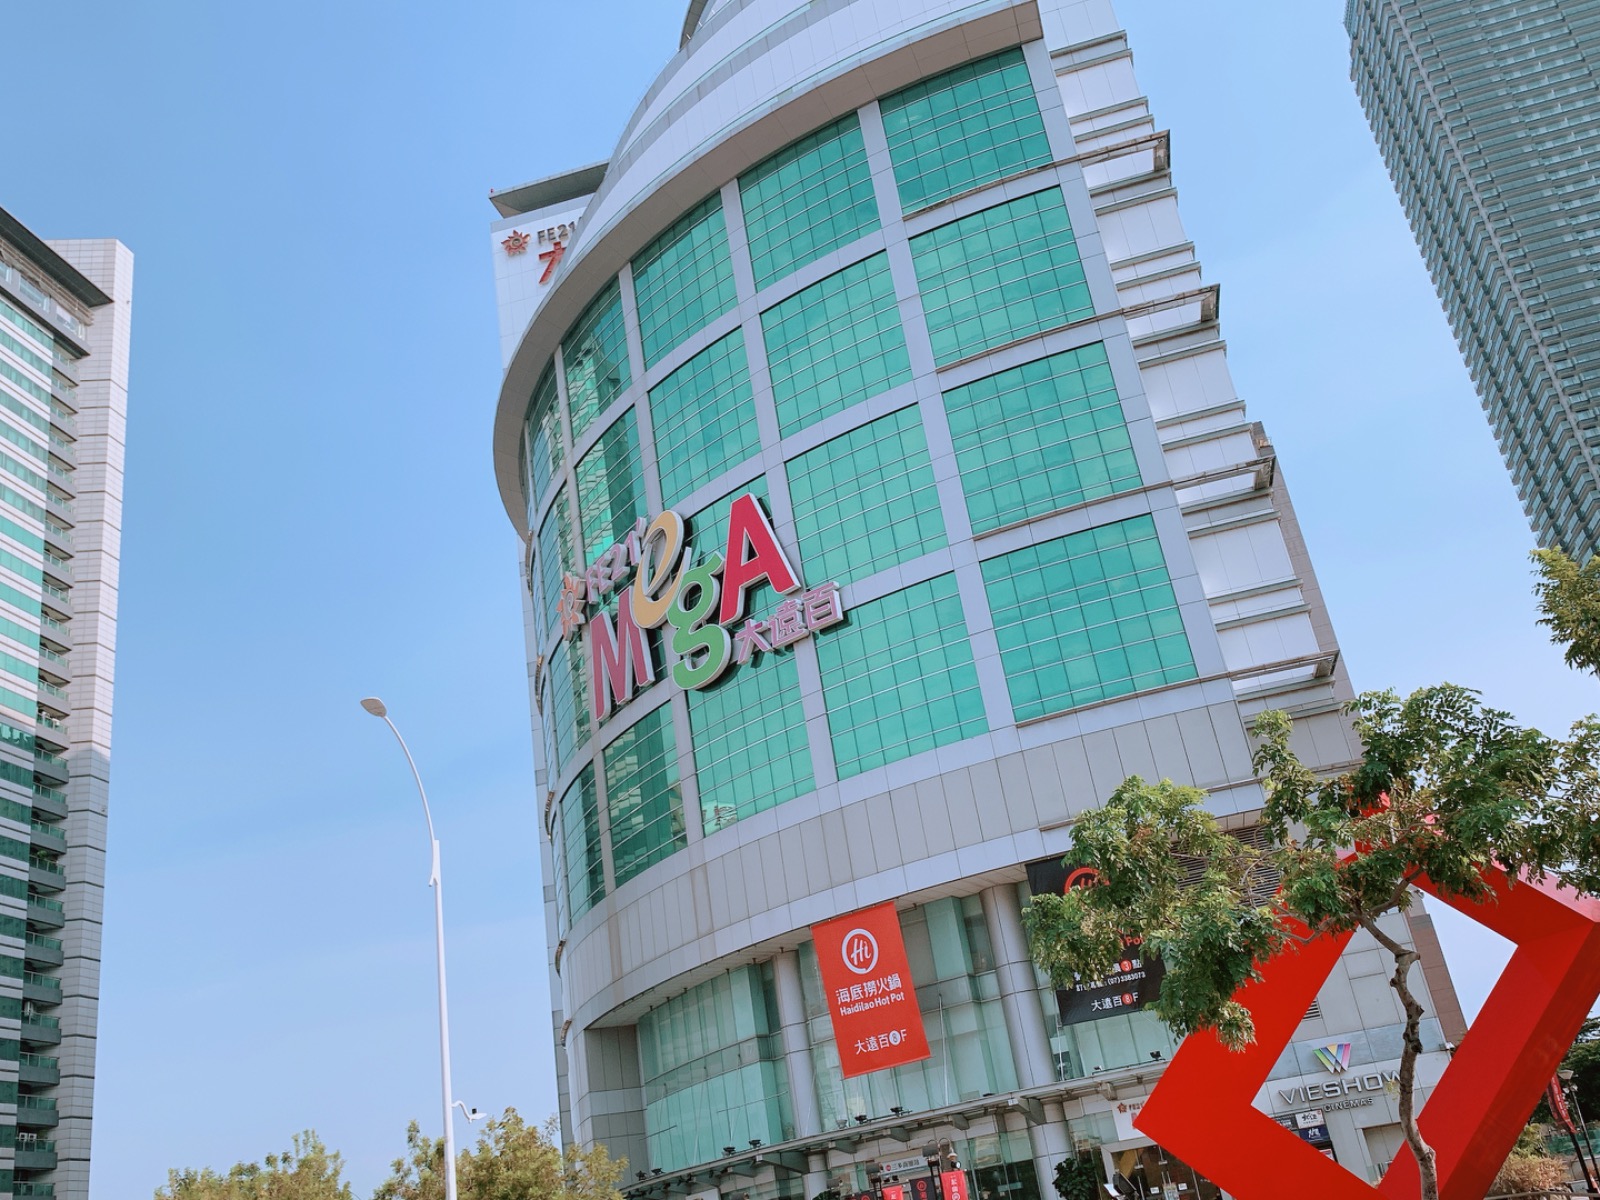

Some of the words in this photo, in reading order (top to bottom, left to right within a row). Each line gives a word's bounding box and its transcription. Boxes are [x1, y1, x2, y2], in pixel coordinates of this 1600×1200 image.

[735, 581, 843, 665] 大遠百
[850, 938, 873, 966] Hi
[835, 973, 902, 1005] 海底撈火鍋
[839, 1001, 875, 1016] Haidilao
[874, 996, 890, 1008] Hot
[890, 991, 905, 1004] Pot
[1323, 1098, 1374, 1113] CINEMAS
